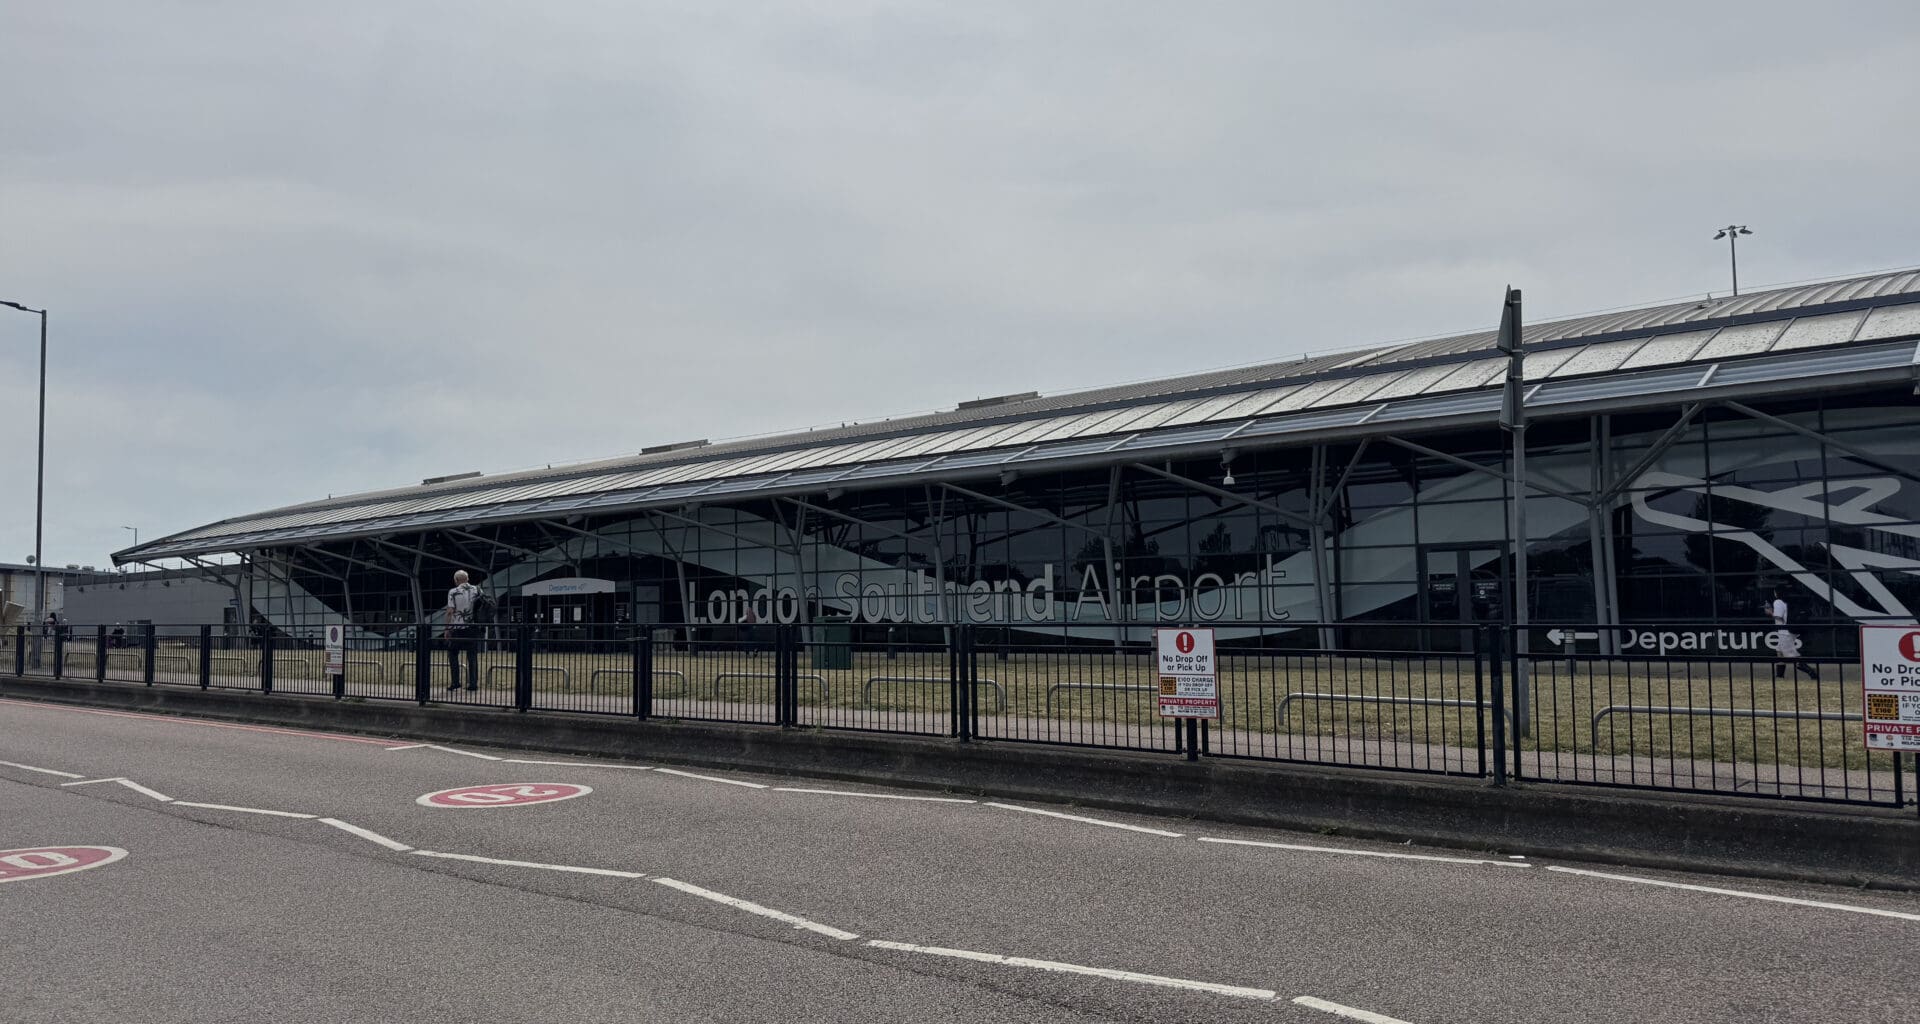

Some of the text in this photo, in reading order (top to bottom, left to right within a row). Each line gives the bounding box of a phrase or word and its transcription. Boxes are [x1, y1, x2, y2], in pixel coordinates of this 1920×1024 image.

[688, 553, 1290, 624] London Southend Airport
[1176, 655, 1194, 663] Drop
[1195, 664, 1206, 672] Up
[1872, 663, 1892, 674] No
[1880, 677, 1895, 686] or
[1867, 724, 1913, 733] PRIVATE
[0, 851, 79, 875] 0
